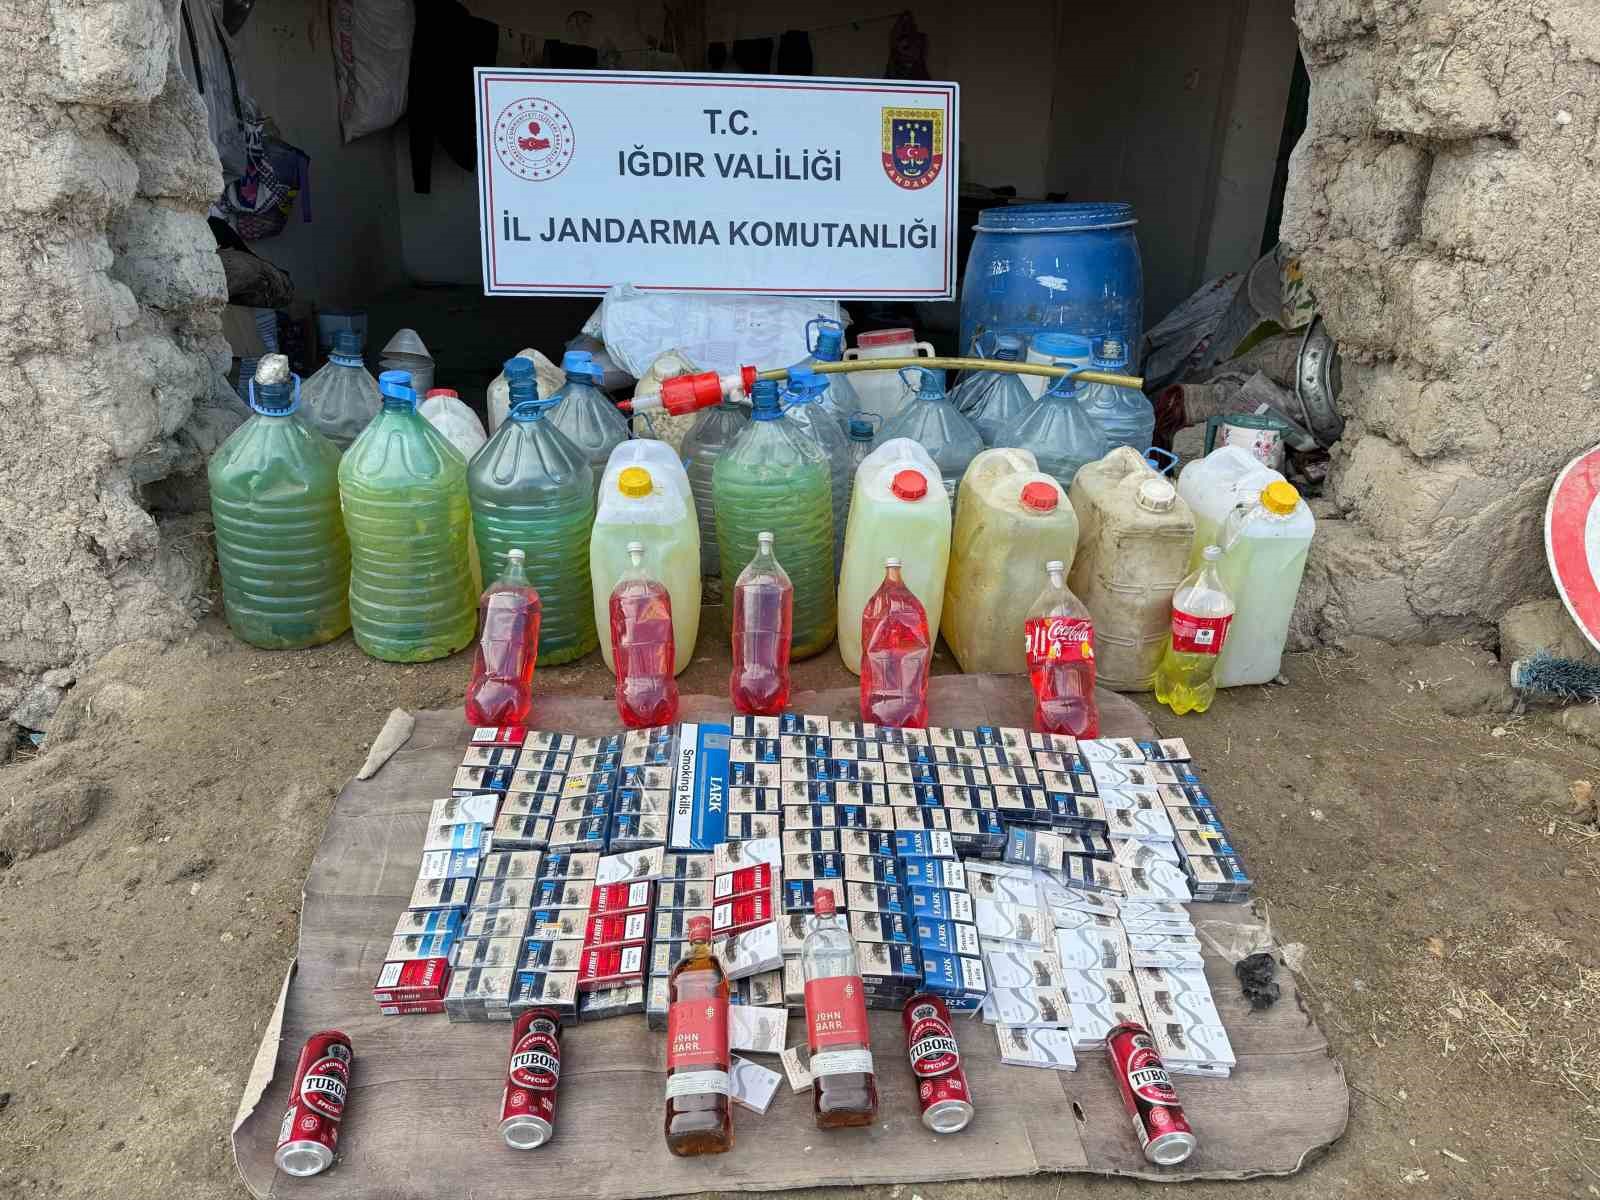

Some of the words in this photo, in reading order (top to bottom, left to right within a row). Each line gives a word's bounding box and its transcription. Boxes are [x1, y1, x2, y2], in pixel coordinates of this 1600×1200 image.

[703, 109, 758, 136] T.C.
[618, 145, 705, 178] IĞDIR
[714, 147, 842, 181] VALİLİĞİ
[503, 210, 530, 242] İL
[540, 216, 720, 247] JANDARMA
[729, 217, 937, 249] KOMUTANLIĞI
[1048, 619, 1089, 641] Coca-Cola
[678, 748, 694, 792] Smoking
[678, 795, 691, 815] kills
[708, 776, 723, 815] LARK
[914, 833, 923, 853] LARK
[926, 862, 935, 884] LARK
[932, 891, 941, 915] LARK
[937, 920, 947, 947] LARK
[944, 957, 953, 982] LARK
[816, 1011, 841, 1022] JOHN
[816, 1020, 842, 1032] BARR
[673, 1032, 699, 1043] JOHN
[673, 1041, 702, 1053] BARR
